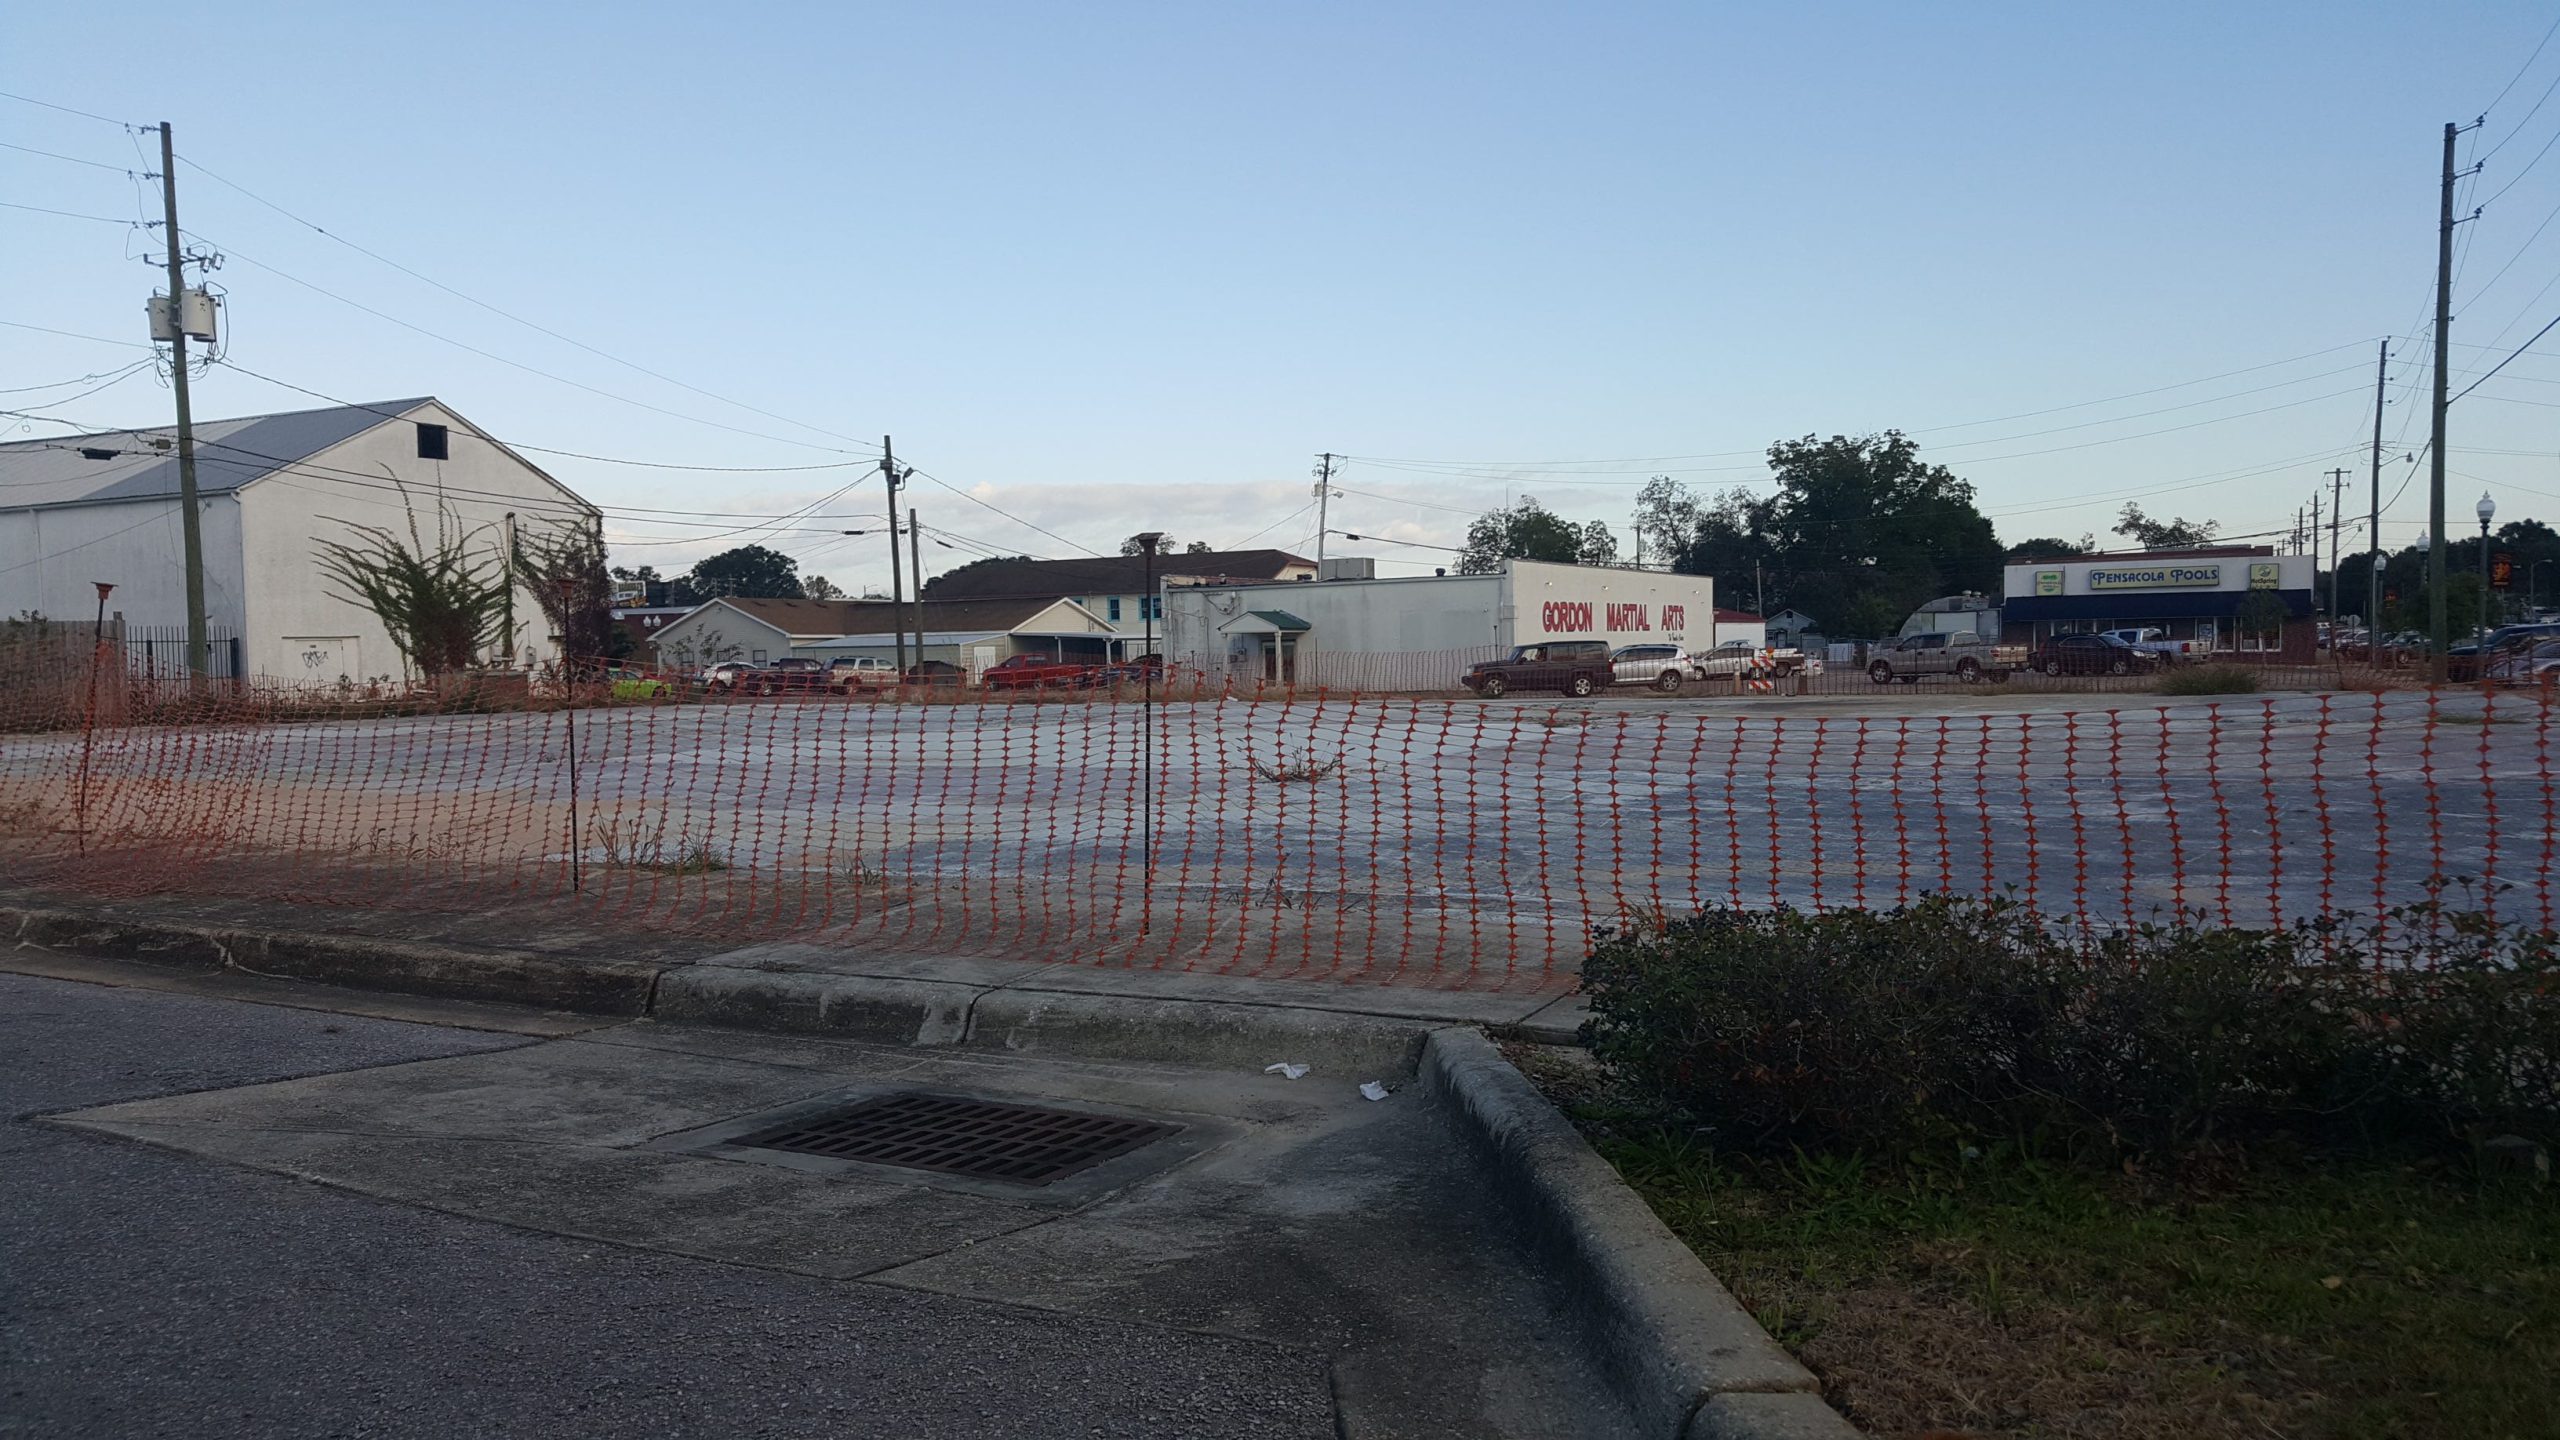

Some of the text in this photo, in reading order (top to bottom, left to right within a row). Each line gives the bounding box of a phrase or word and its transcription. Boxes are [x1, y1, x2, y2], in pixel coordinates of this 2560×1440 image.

[2092, 569, 2218, 585] PENSACOLA POOLS
[1543, 601, 1684, 632] GORDON MARTIAL ARTS
